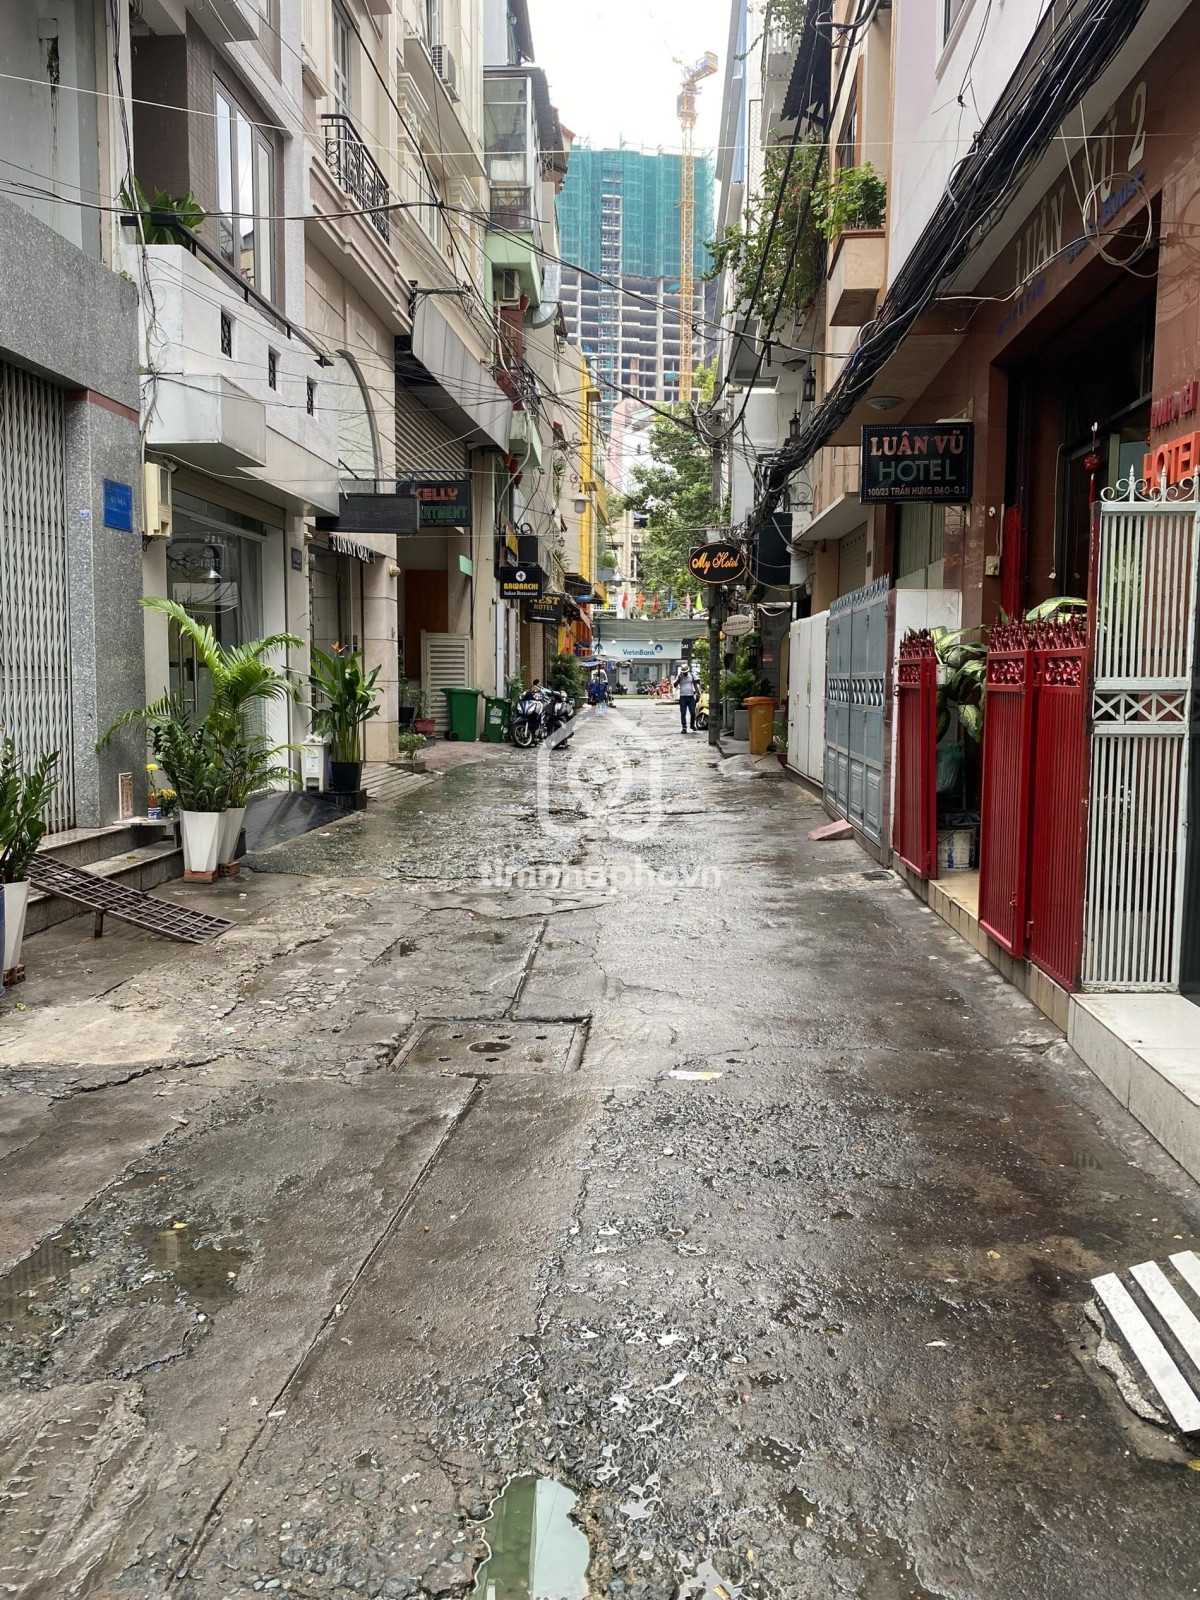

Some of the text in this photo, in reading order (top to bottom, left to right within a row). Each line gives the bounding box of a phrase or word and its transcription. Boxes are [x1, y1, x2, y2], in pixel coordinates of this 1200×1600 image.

[1014, 184, 1066, 300] LUÂN
[1127, 81, 1147, 172] 2
[870, 429, 965, 456] LUÂN VŨ
[878, 459, 957, 482] HOTEL
[1141, 431, 1200, 497] HOTEL
[415, 487, 459, 501] KELLY
[868, 487, 889, 496] 100/23
[911, 485, 933, 496] HƯNG
[332, 534, 357, 557] SUNNY
[692, 552, 740, 575] My Hotel
